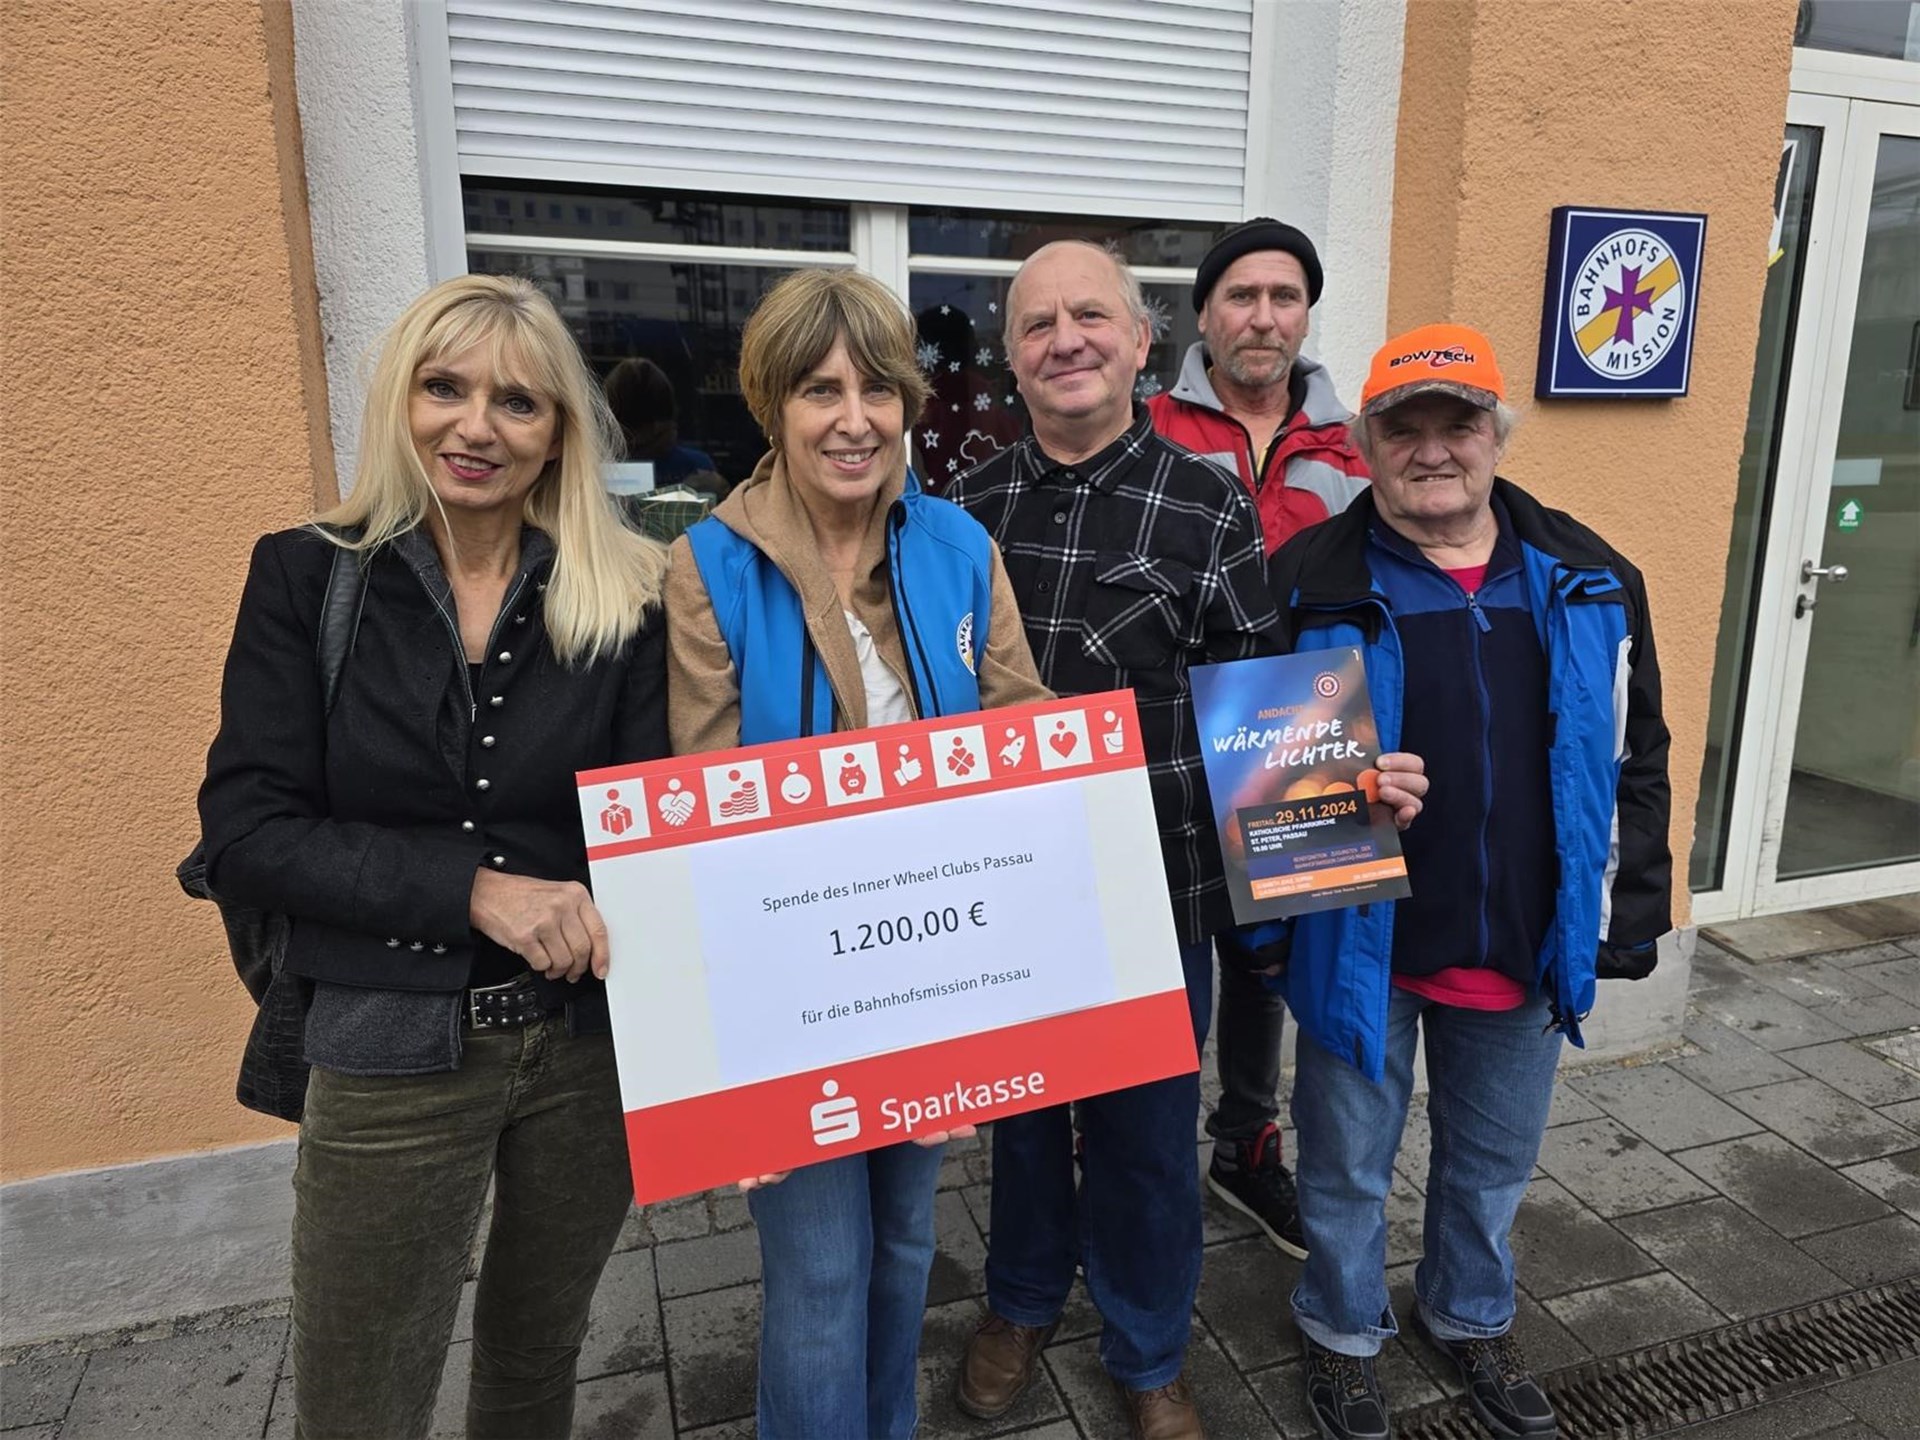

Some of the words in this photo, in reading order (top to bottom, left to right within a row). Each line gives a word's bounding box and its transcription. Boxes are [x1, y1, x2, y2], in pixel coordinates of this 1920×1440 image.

[1577, 238, 1660, 316] BAHNHOFS
[1389, 349, 1475, 367] BOWTECH
[1606, 307, 1676, 370] MISSION
[1213, 718, 1343, 753] WÄRMENDE
[1264, 740, 1366, 769] LICHTER
[1275, 800, 1358, 824] 29.11.2024
[762, 889, 819, 913] Spende
[823, 884, 850, 900] des
[853, 876, 892, 895] Inner
[893, 865, 939, 887] Wheel
[942, 859, 980, 878] Clubs
[984, 851, 1034, 870] Passau
[830, 907, 960, 956] 1.200,00
[967, 901, 988, 927] €
[801, 1009, 823, 1025] für
[827, 1002, 850, 1019] die
[854, 978, 978, 1014] Bahnhofsmission
[981, 967, 1031, 986] Passau
[880, 1071, 1045, 1133] Sparkasse
